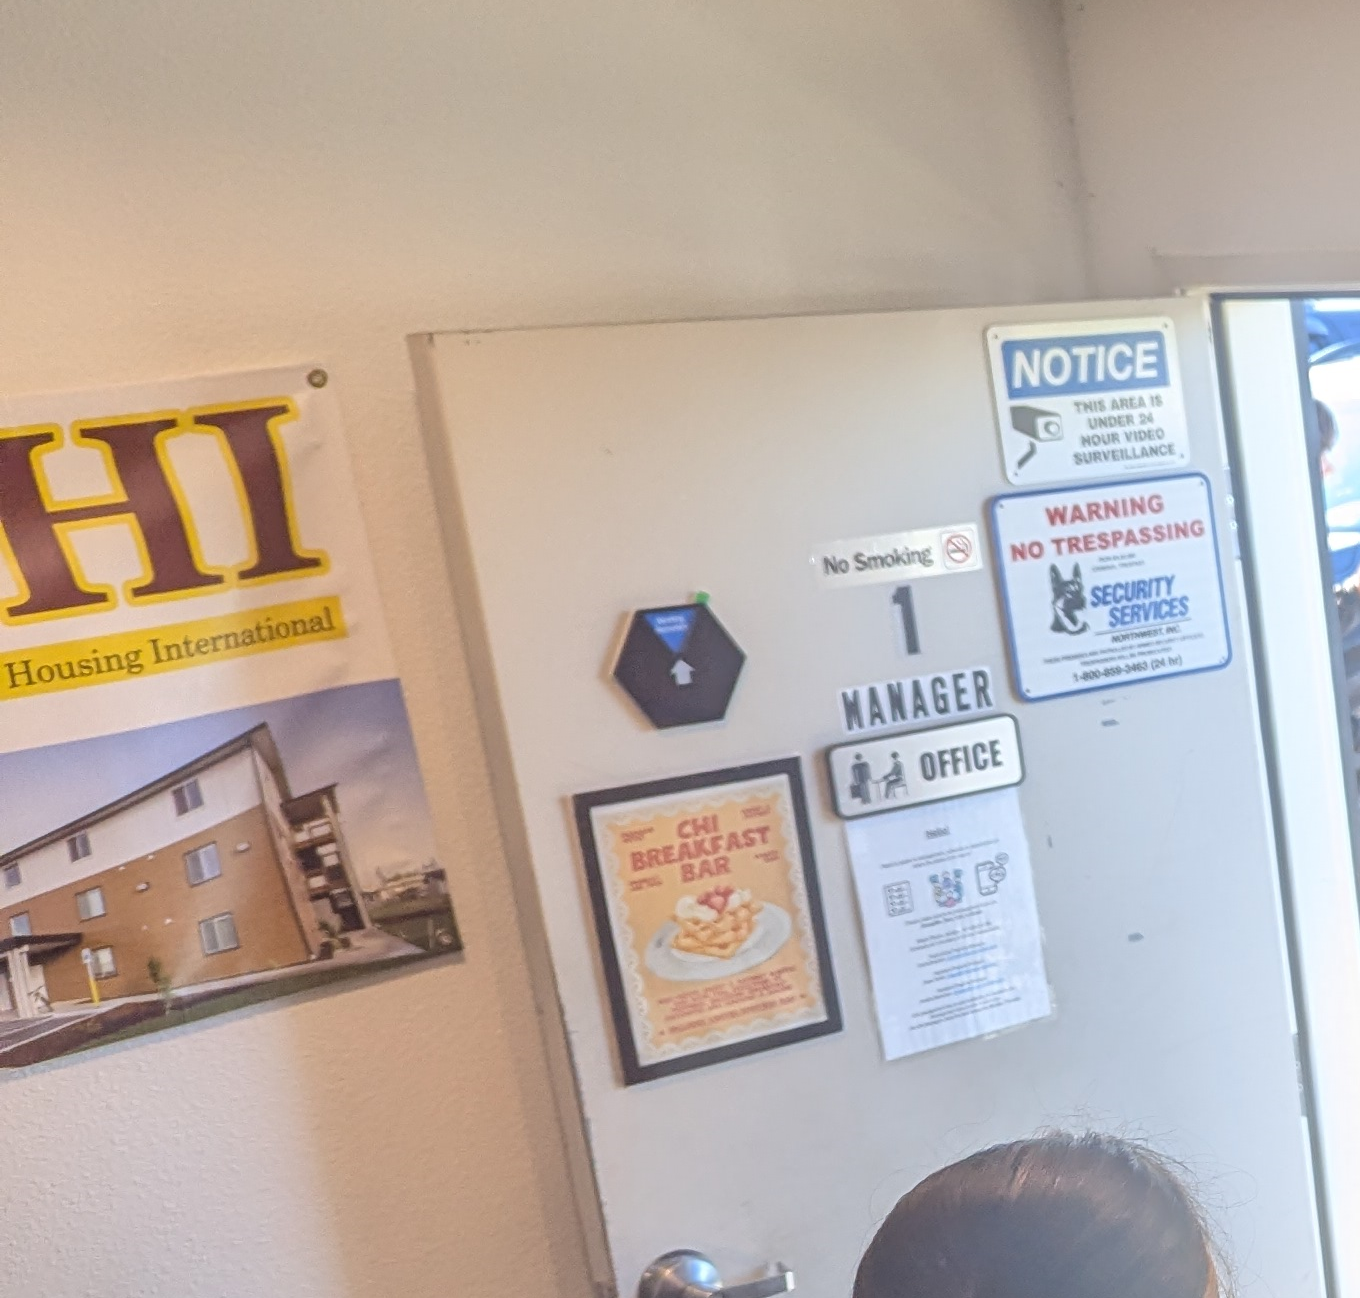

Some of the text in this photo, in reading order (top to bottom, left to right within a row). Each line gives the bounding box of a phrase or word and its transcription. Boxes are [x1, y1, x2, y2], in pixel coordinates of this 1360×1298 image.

[1012, 341, 1159, 389] NOTICE
[1073, 394, 1163, 413] THIS AREA IS
[1087, 411, 1154, 430] UNDER 24
[1080, 427, 1165, 448] HOUR VIDEO
[1073, 442, 1176, 466] SURVEILLANCE
[1045, 494, 1164, 526] WARNING
[1009, 520, 1205, 562] NO TRESPASSING
[823, 546, 934, 576] No Smoking
[1090, 575, 1175, 607] SECURITY
[892, 585, 921, 655] 1
[1109, 596, 1189, 628] SERVICES
[4, 606, 336, 688] Housing International
[841, 669, 993, 732] MANAGER
[920, 739, 1004, 782] OFFICE
[677, 814, 719, 839] CHI
[630, 826, 771, 872] BREAKFAST
[680, 856, 731, 883] BAR
